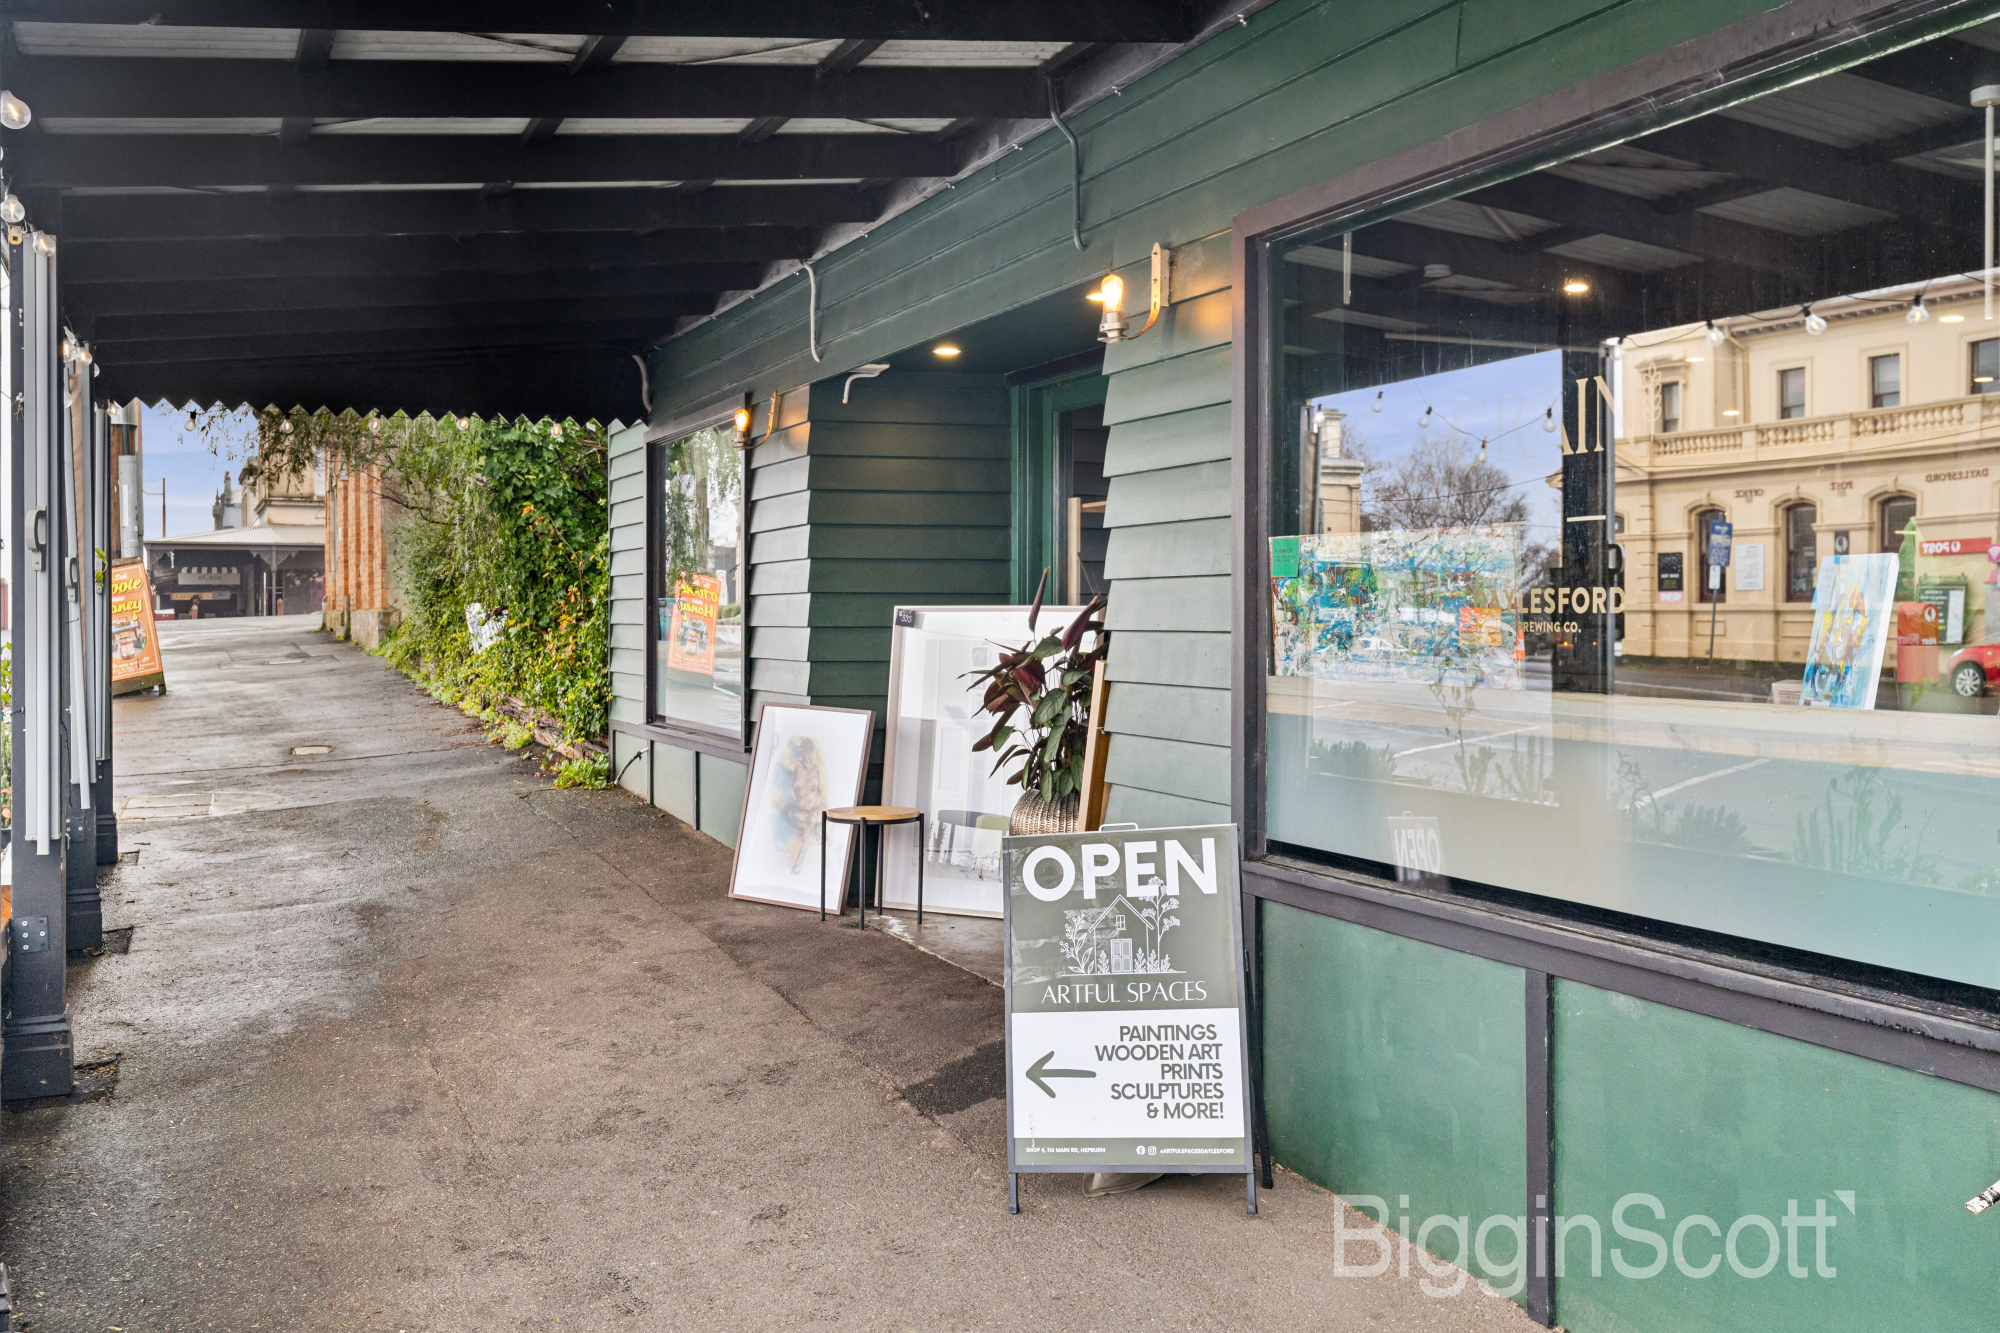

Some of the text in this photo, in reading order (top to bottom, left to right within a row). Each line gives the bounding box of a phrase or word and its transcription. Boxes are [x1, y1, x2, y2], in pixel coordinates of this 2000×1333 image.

[1473, 586, 1626, 614] DAYLESFORD
[1518, 621, 1582, 633] BREWING CO.
[1022, 838, 1218, 902] OPEN
[1041, 980, 1207, 1004] ARTFUL SPACES
[1119, 1024, 1217, 1041] PAINTINGS
[1095, 1043, 1222, 1061] WOODEN ART
[1161, 1062, 1223, 1080] PRINTS
[1110, 1082, 1224, 1100] SCULPTURES
[1147, 1102, 1224, 1119] & MORE!
